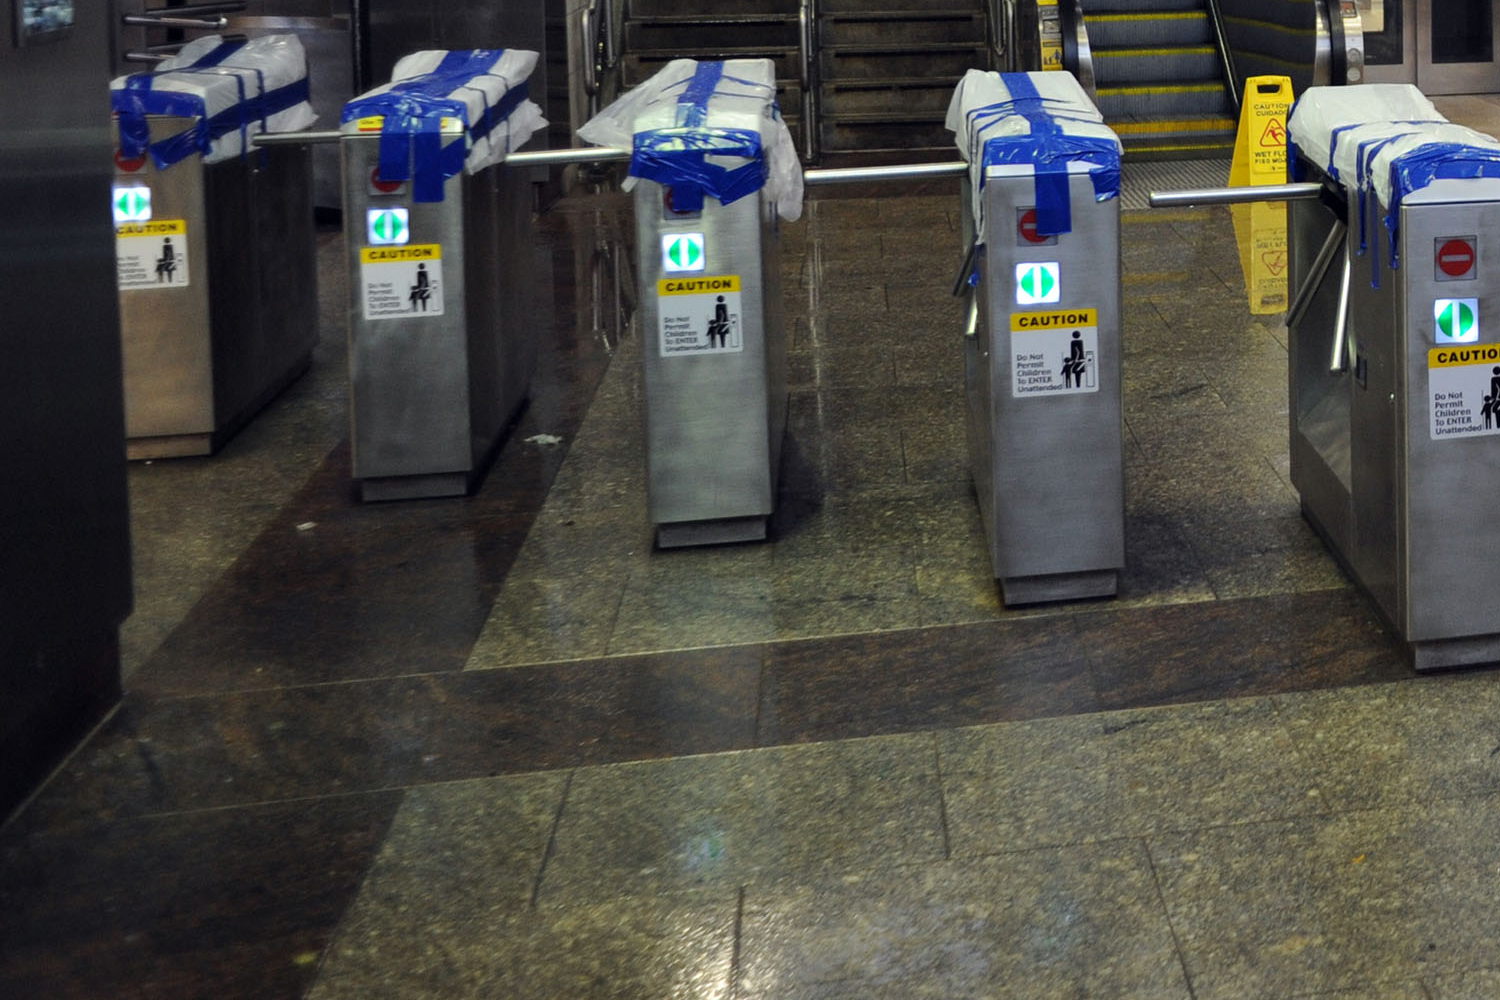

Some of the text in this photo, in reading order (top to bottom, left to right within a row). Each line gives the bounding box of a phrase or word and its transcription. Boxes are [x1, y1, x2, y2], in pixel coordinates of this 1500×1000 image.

[369, 248, 433, 259] CAUTION
[665, 279, 732, 291] CAUTION
[1018, 313, 1088, 327] CAUTION
[1016, 361, 1044, 369] Permit
[1016, 369, 1052, 377] Children
[1028, 376, 1052, 384] ENTER
[1017, 383, 1063, 393] Unattended
[1434, 401, 1463, 409] Permit
[1434, 409, 1471, 418] Children
[1446, 417, 1472, 425] ENTER
[1435, 424, 1482, 435] Unattended
